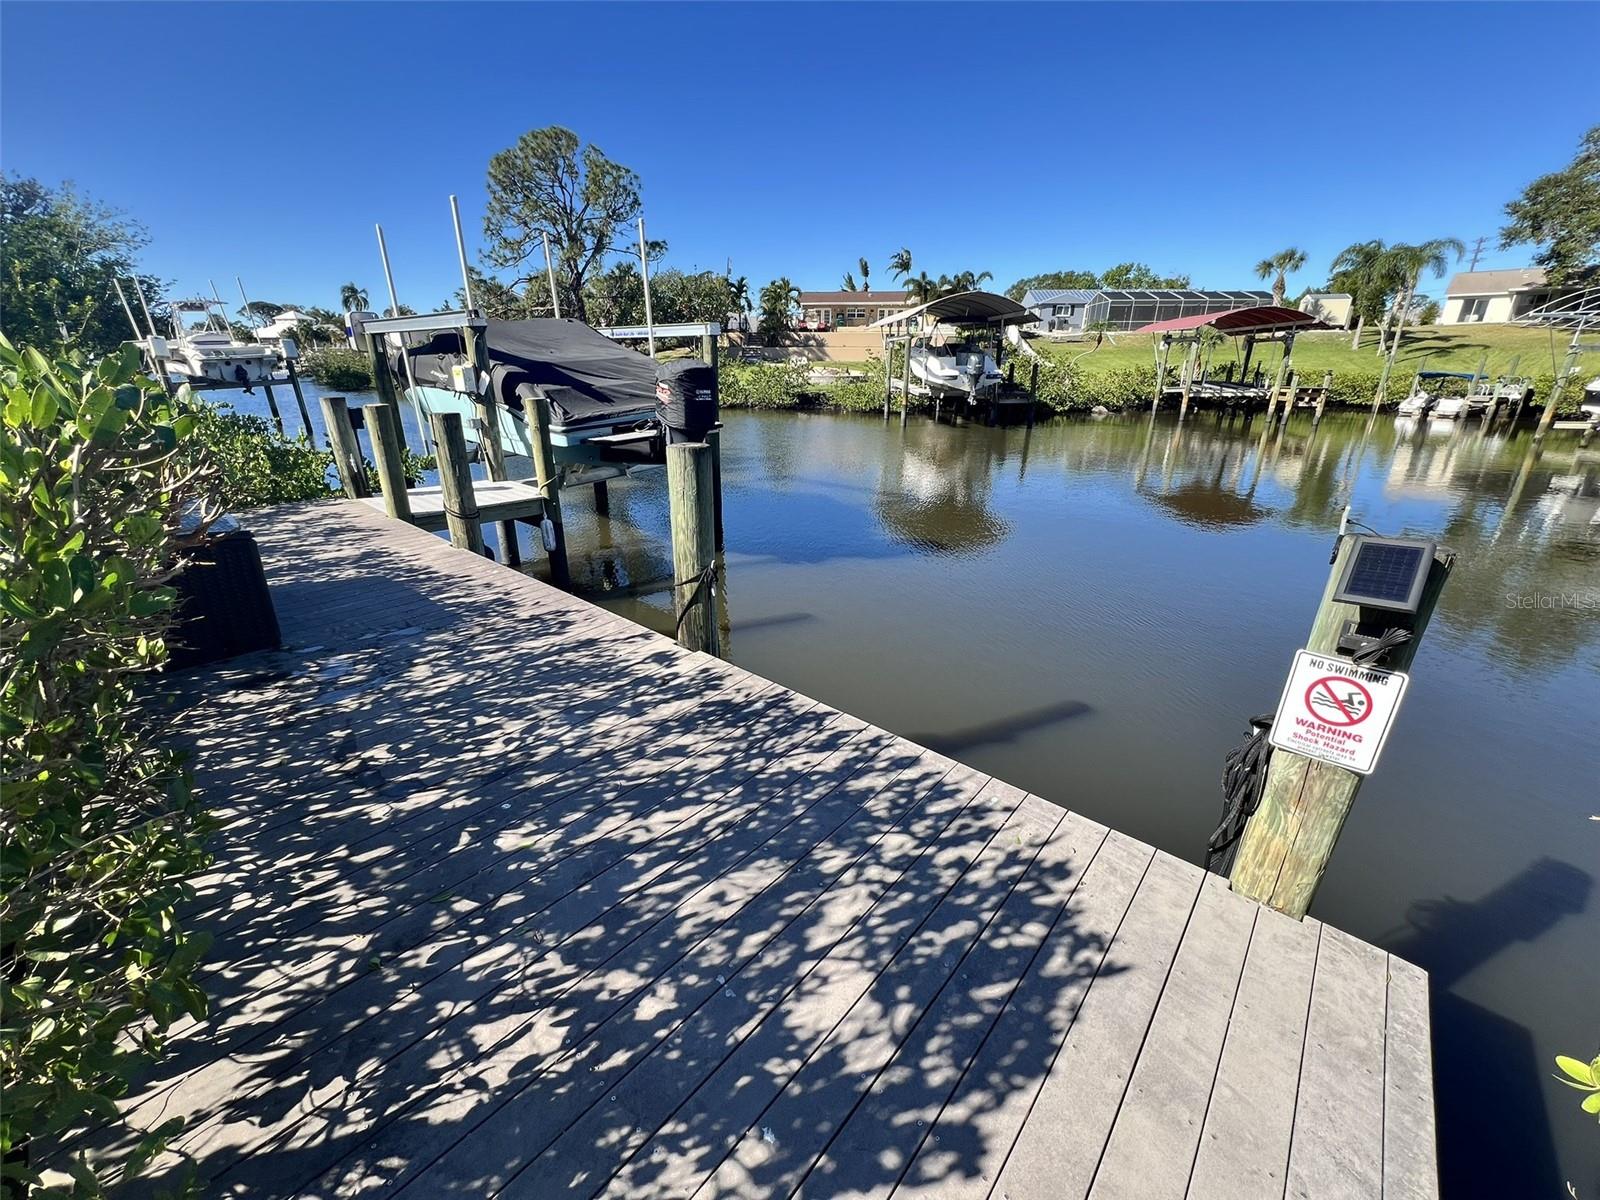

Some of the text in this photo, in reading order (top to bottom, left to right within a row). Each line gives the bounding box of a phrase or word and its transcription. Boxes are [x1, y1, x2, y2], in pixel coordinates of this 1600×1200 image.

[1309, 658, 1389, 686] NO SWIMMING
[1295, 717, 1363, 743] WARNING
[1305, 728, 1346, 746] Potential
[1292, 731, 1319, 745] Shock
[1322, 741, 1356, 756] Hazard
